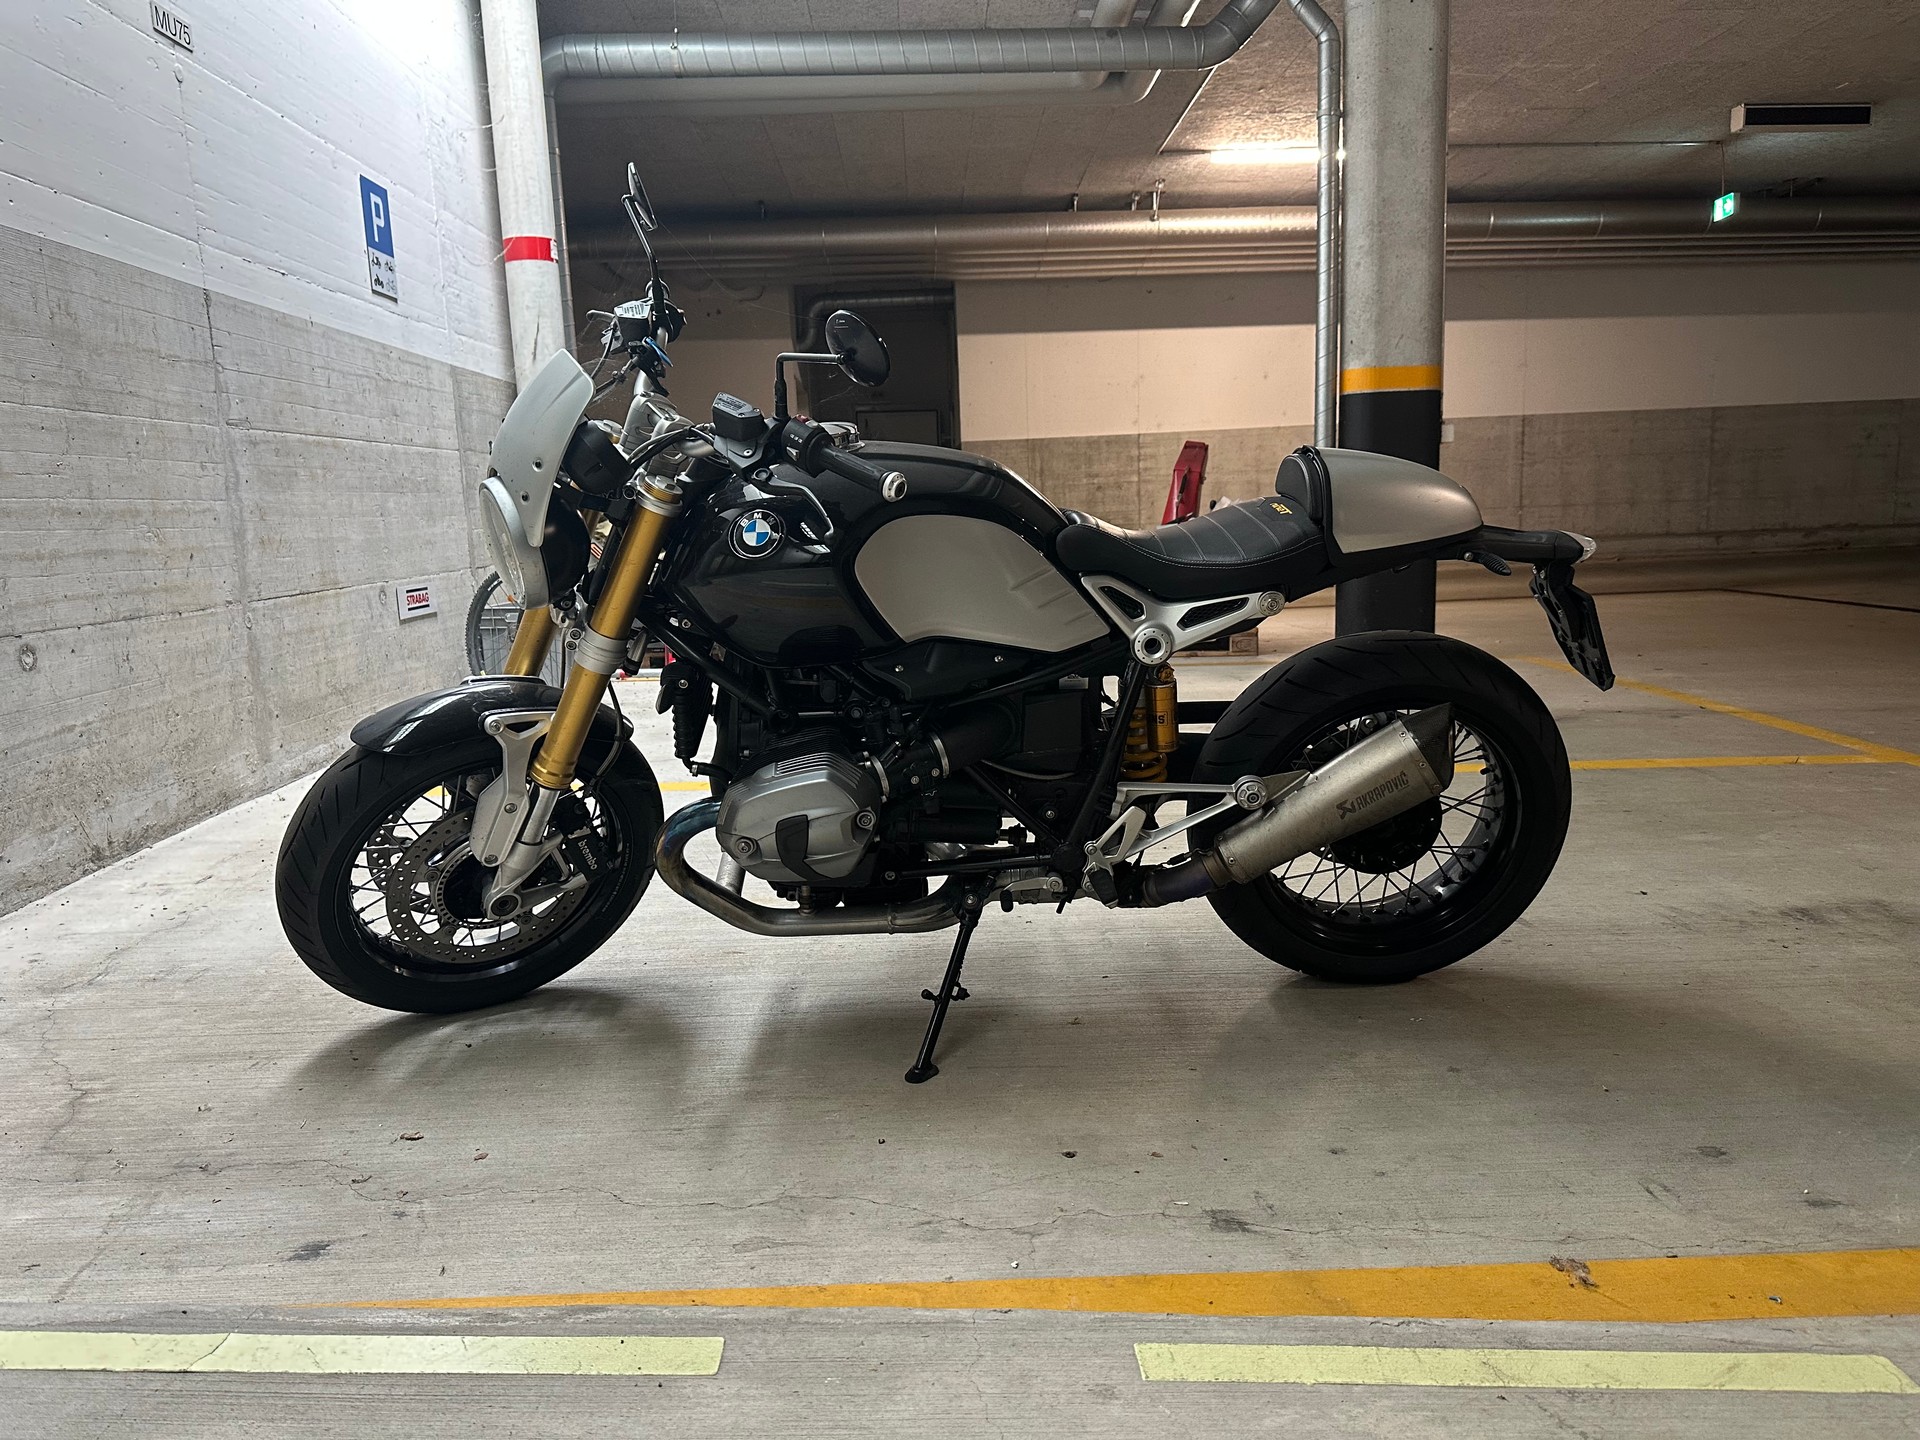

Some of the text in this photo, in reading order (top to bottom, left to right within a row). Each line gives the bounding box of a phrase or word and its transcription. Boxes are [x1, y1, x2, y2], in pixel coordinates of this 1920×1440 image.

[155, 5, 191, 46] MU75
[369, 191, 386, 243] P
[740, 512, 777, 528] BMW
[406, 592, 430, 606] STRABAG
[578, 839, 598, 870] brembo
